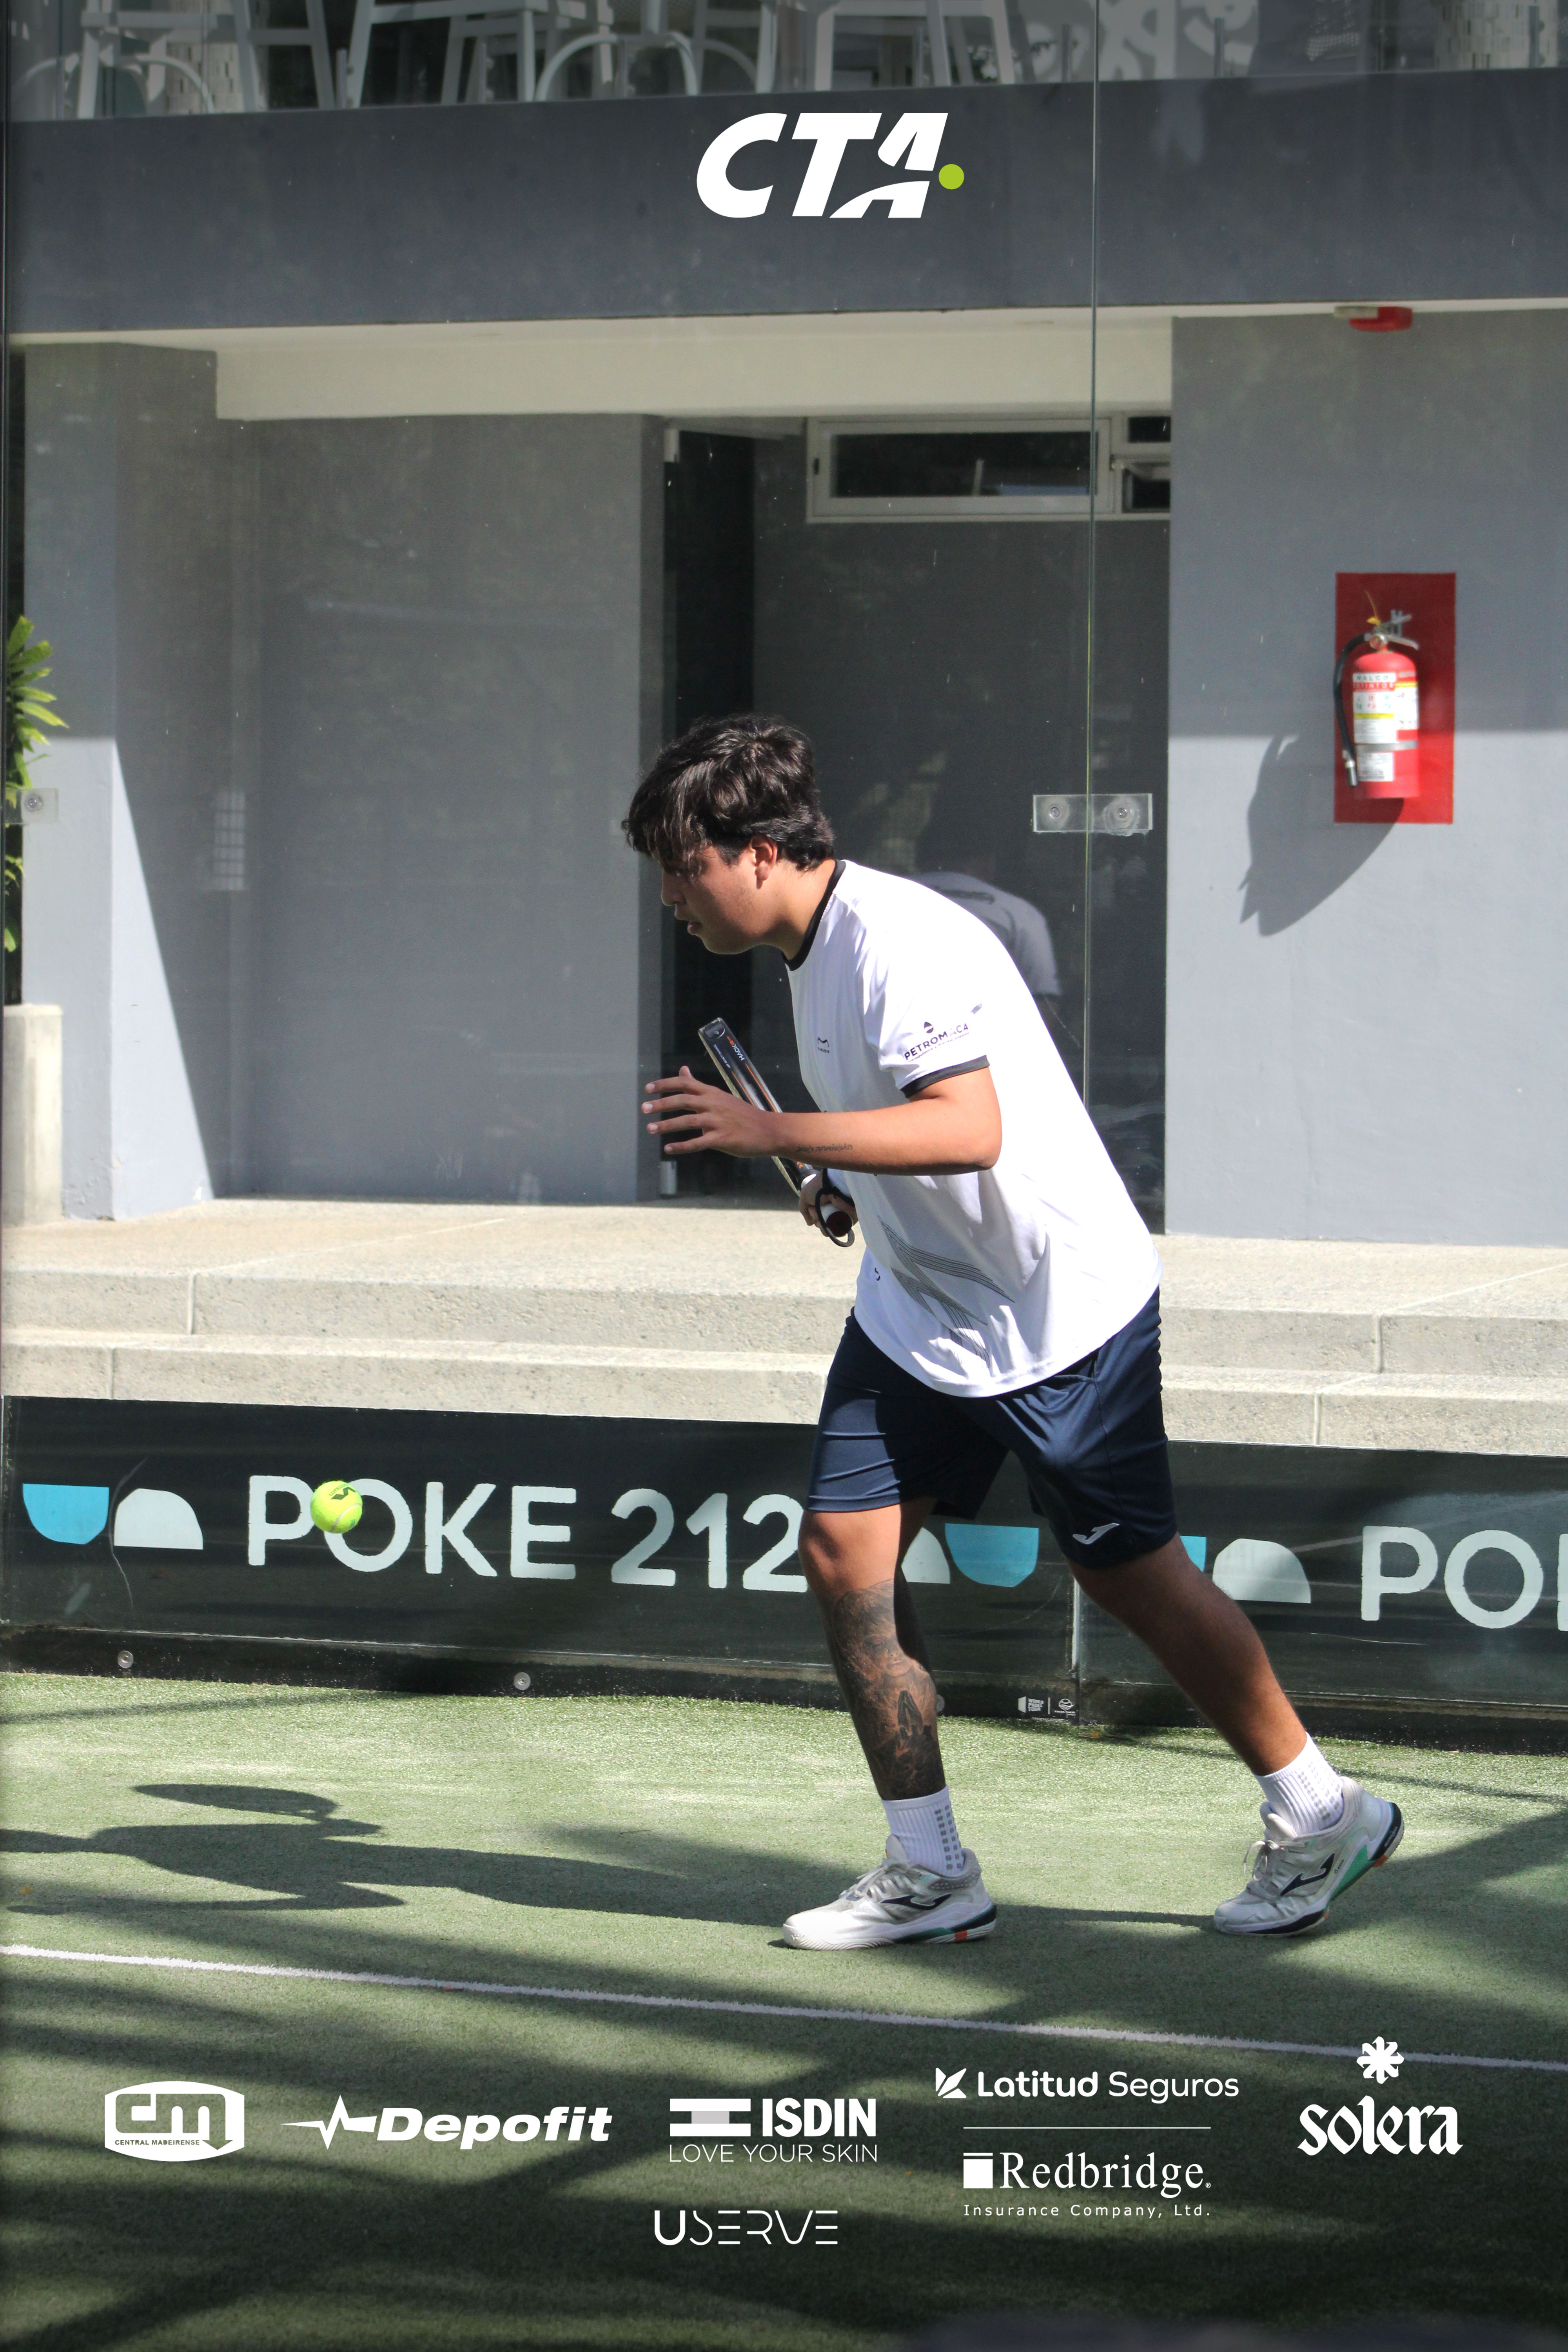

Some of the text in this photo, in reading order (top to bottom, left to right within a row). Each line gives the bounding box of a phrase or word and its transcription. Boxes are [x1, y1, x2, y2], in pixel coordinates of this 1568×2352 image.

[248, 1475, 808, 1593] POKE 212
[1361, 1525, 1568, 1632] PO
